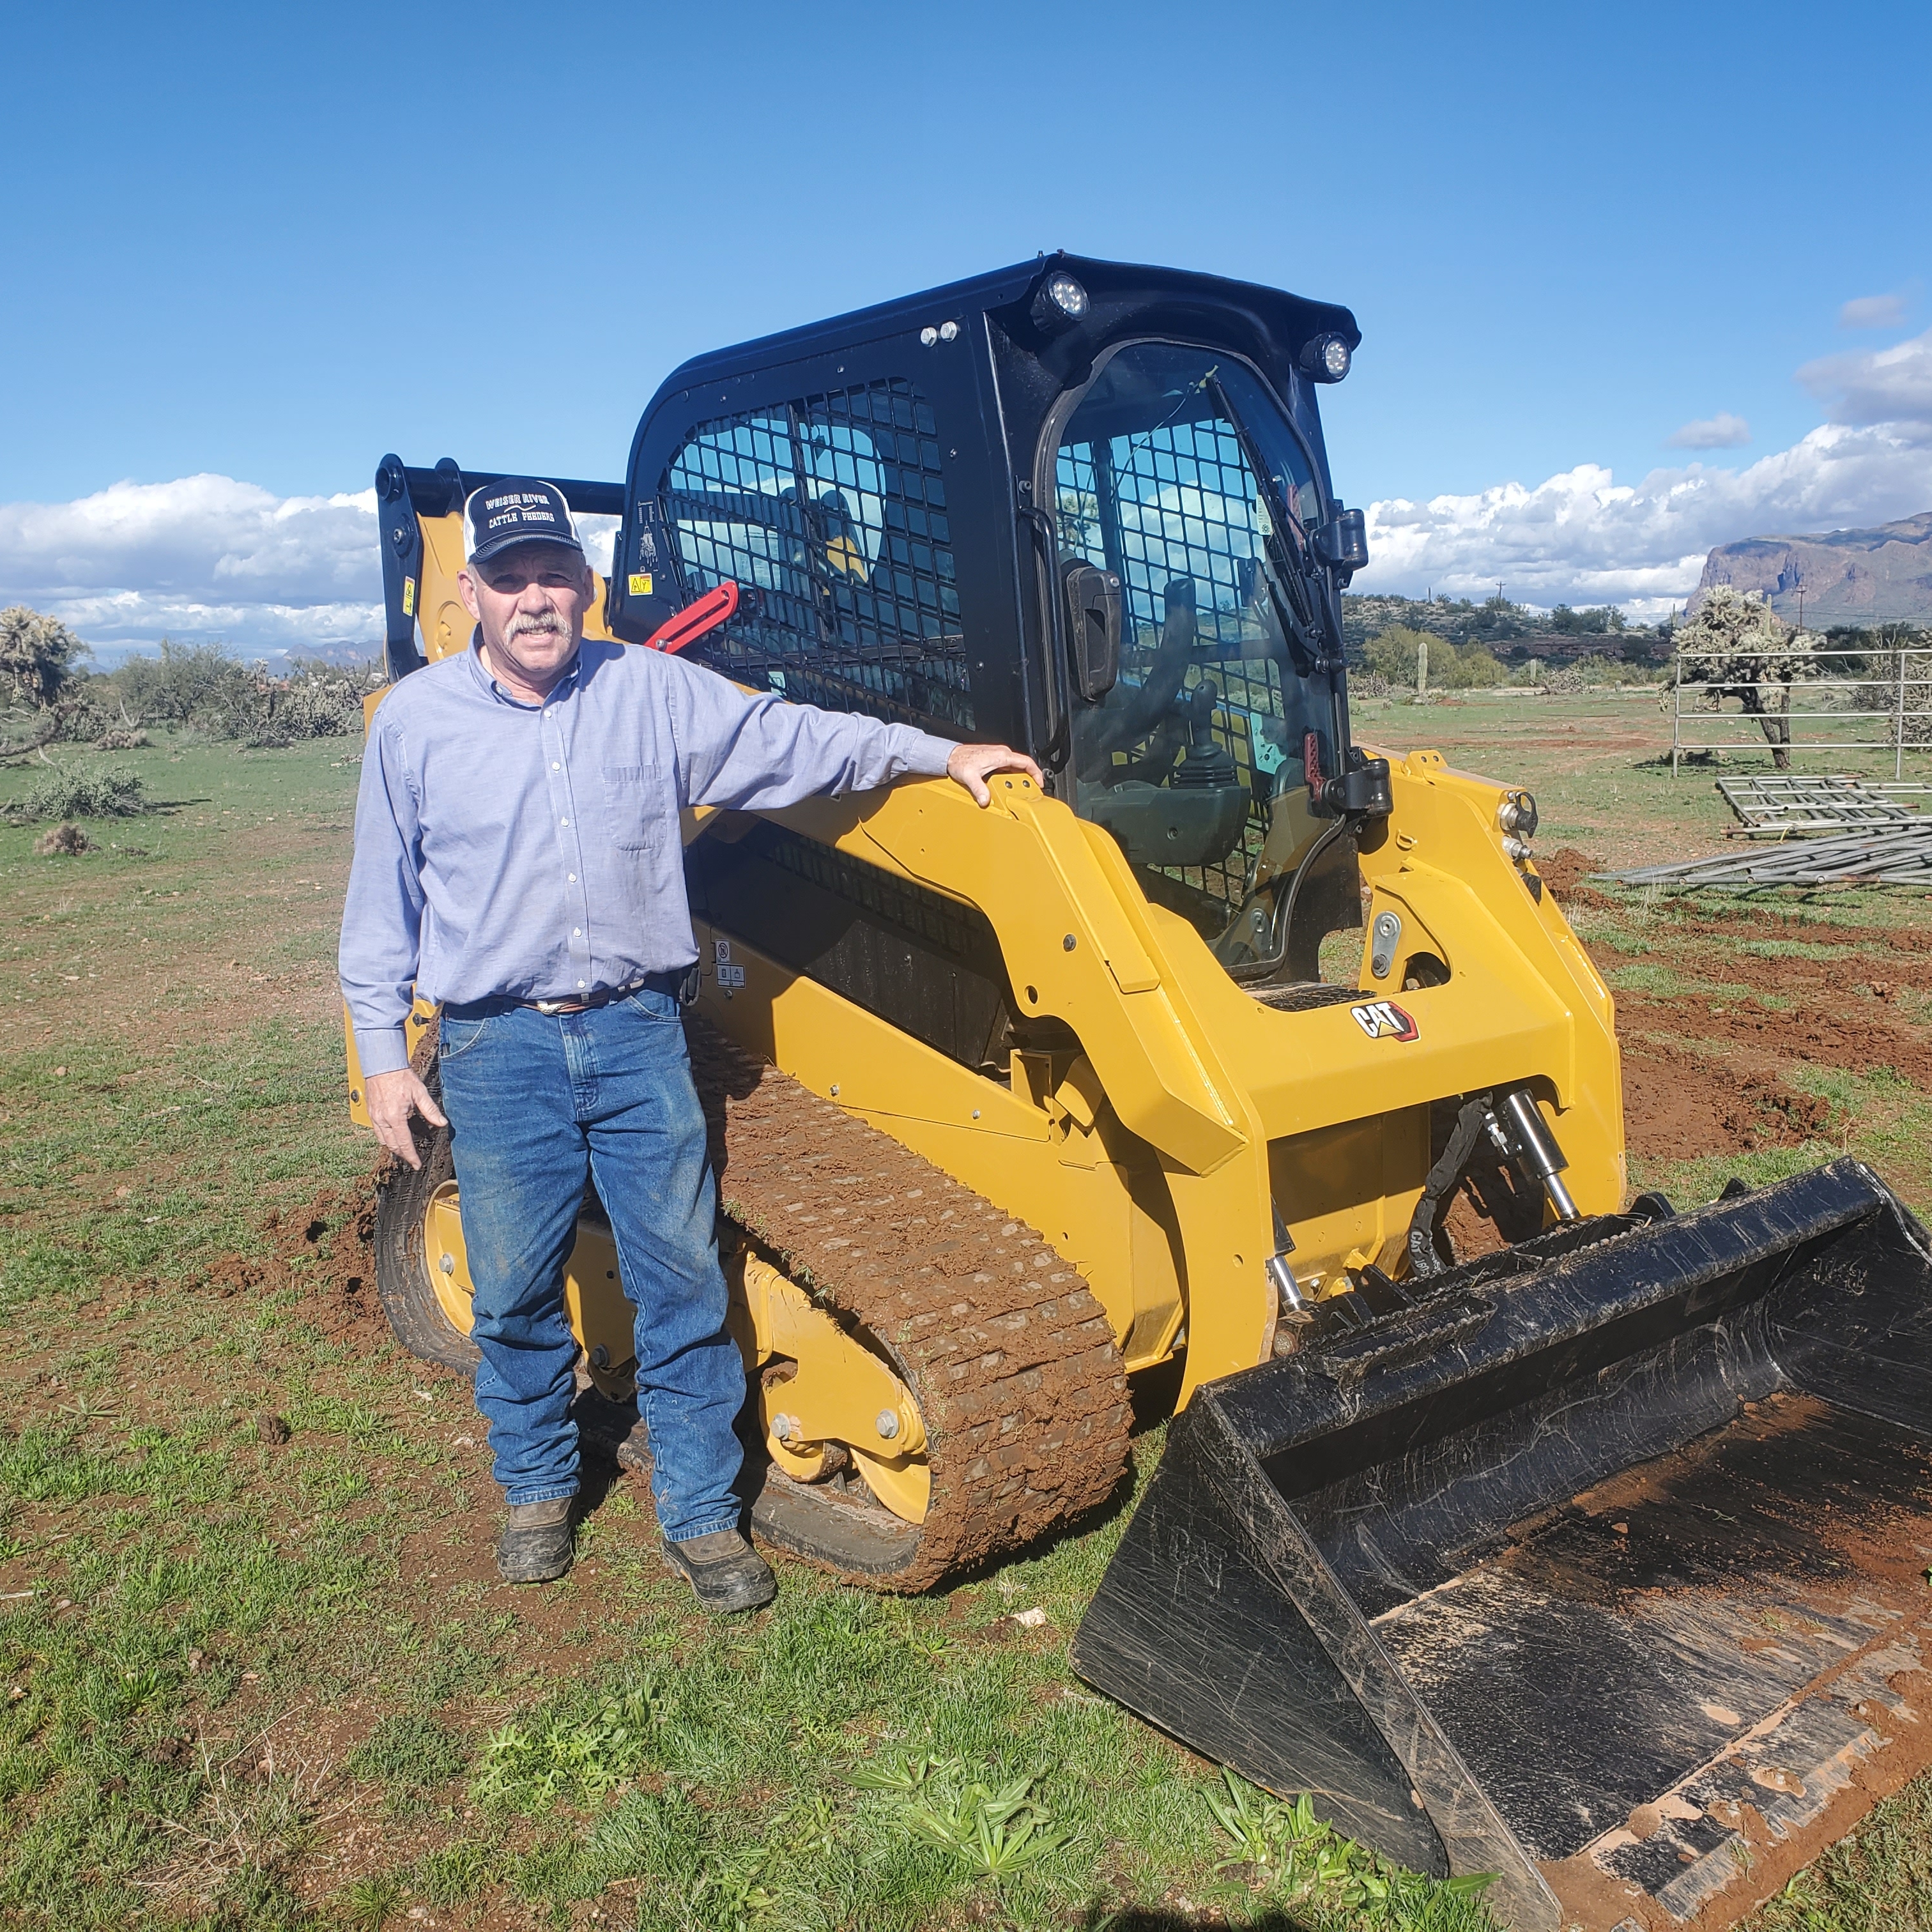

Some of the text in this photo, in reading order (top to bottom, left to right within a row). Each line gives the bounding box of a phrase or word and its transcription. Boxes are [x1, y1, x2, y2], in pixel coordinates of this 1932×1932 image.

[486, 493, 549, 510] WEISER RIVER
[489, 512, 555, 528] CATTLE FEEDERS
[1351, 1002, 1404, 1038] CAT
[1411, 1231, 1423, 1253] CAT
